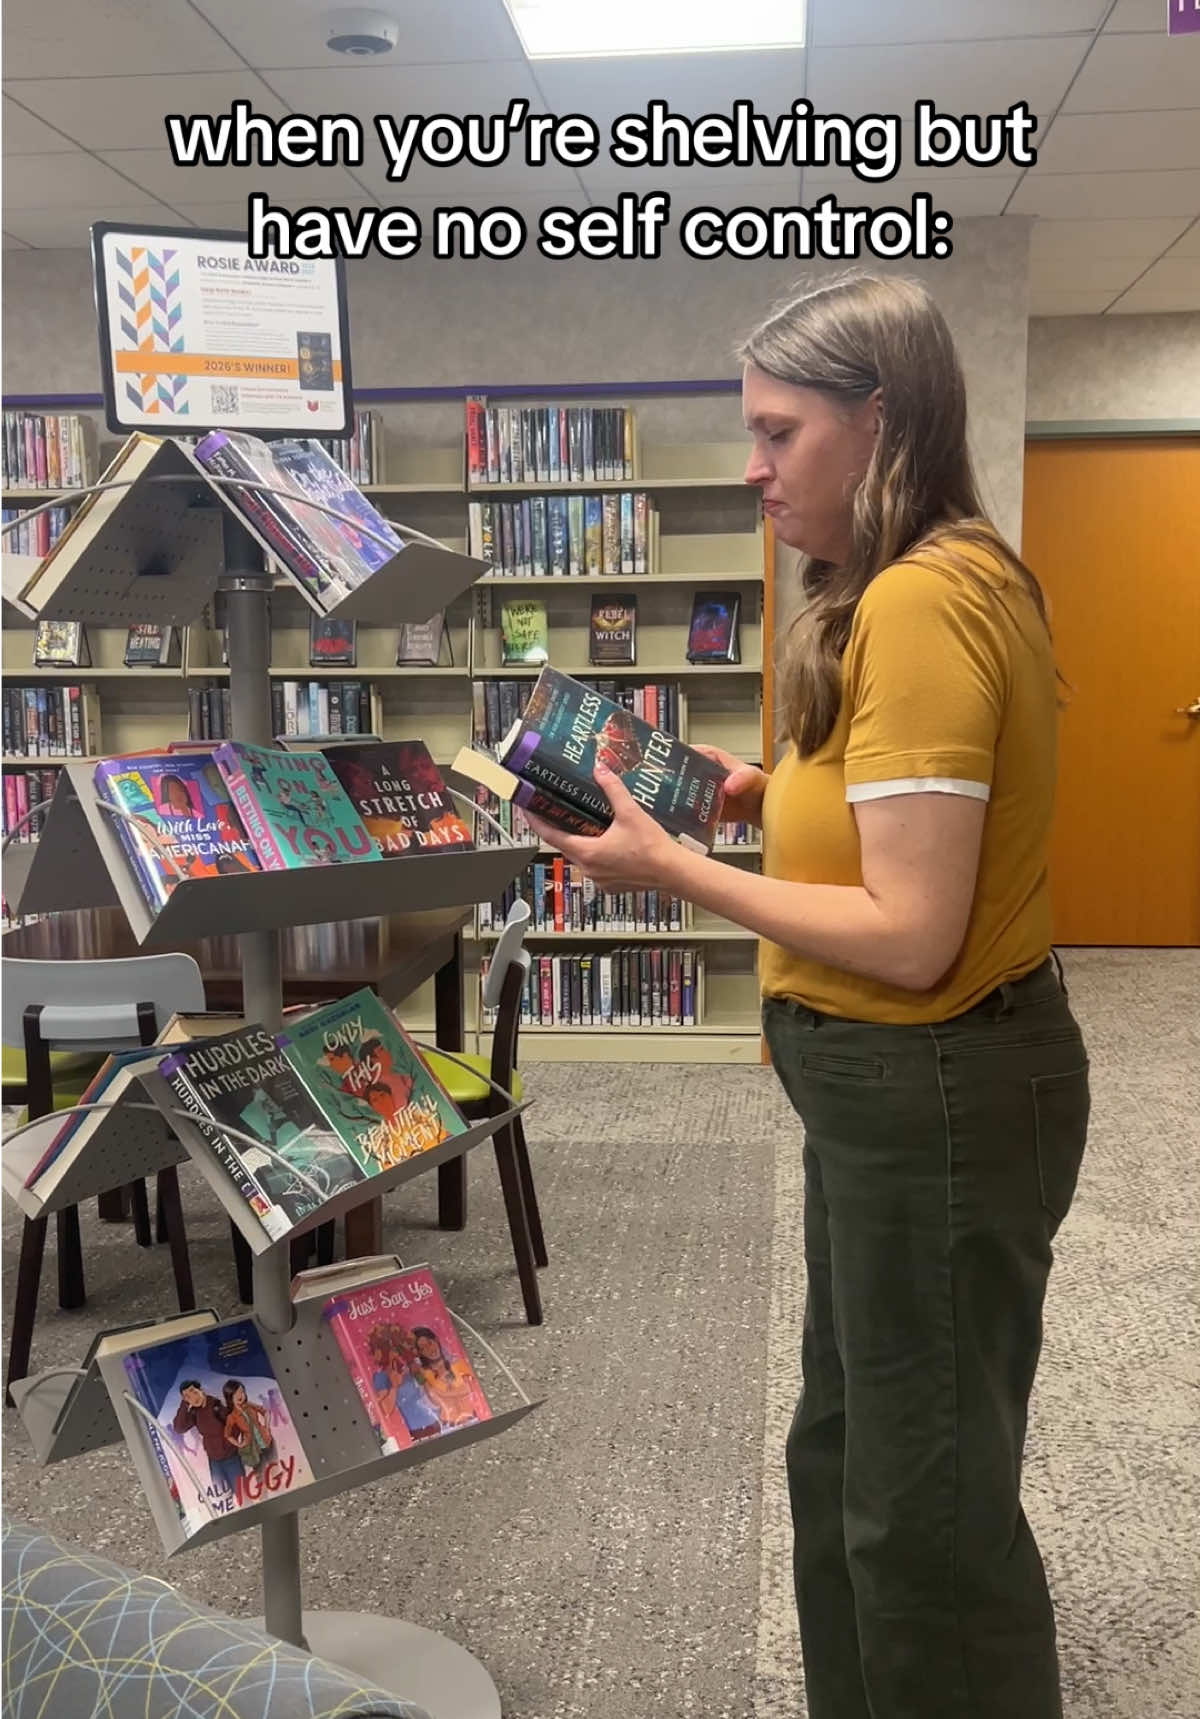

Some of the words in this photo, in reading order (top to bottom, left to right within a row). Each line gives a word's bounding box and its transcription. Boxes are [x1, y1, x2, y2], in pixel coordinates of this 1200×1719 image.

[197, 255, 240, 271] ROSIE
[243, 258, 300, 275] AWARD
[243, 361, 290, 374] WINNER!
[595, 631, 630, 641] WITCH
[562, 692, 602, 765] HEARTLESS
[374, 779, 412, 793] LONG
[381, 764, 391, 777] A
[524, 760, 578, 797] EARTLESS
[632, 731, 675, 810] HUNTER
[359, 791, 444, 816] STRETCH
[401, 815, 419, 829] OF
[180, 833, 211, 842] MISS
[235, 785, 265, 838] BETTING
[259, 837, 275, 860] ON
[274, 822, 371, 860] YOU
[415, 824, 464, 847] DAYS
[323, 1015, 366, 1052] ONLY
[185, 1031, 274, 1079] HURDLES
[198, 1081, 223, 1101] IN
[216, 1071, 250, 1096] THE
[246, 1055, 292, 1084] DARK
[341, 1055, 383, 1093] THIS
[355, 1093, 438, 1165] BEAUTIFUL
[210, 1136, 227, 1155] IN
[221, 1153, 245, 1182] THE
[348, 1300, 379, 1321] Just
[379, 1288, 411, 1309] Say
[408, 1281, 433, 1302] Yes
[234, 1455, 295, 1508] IGGY
[211, 1494, 235, 1514] ME
